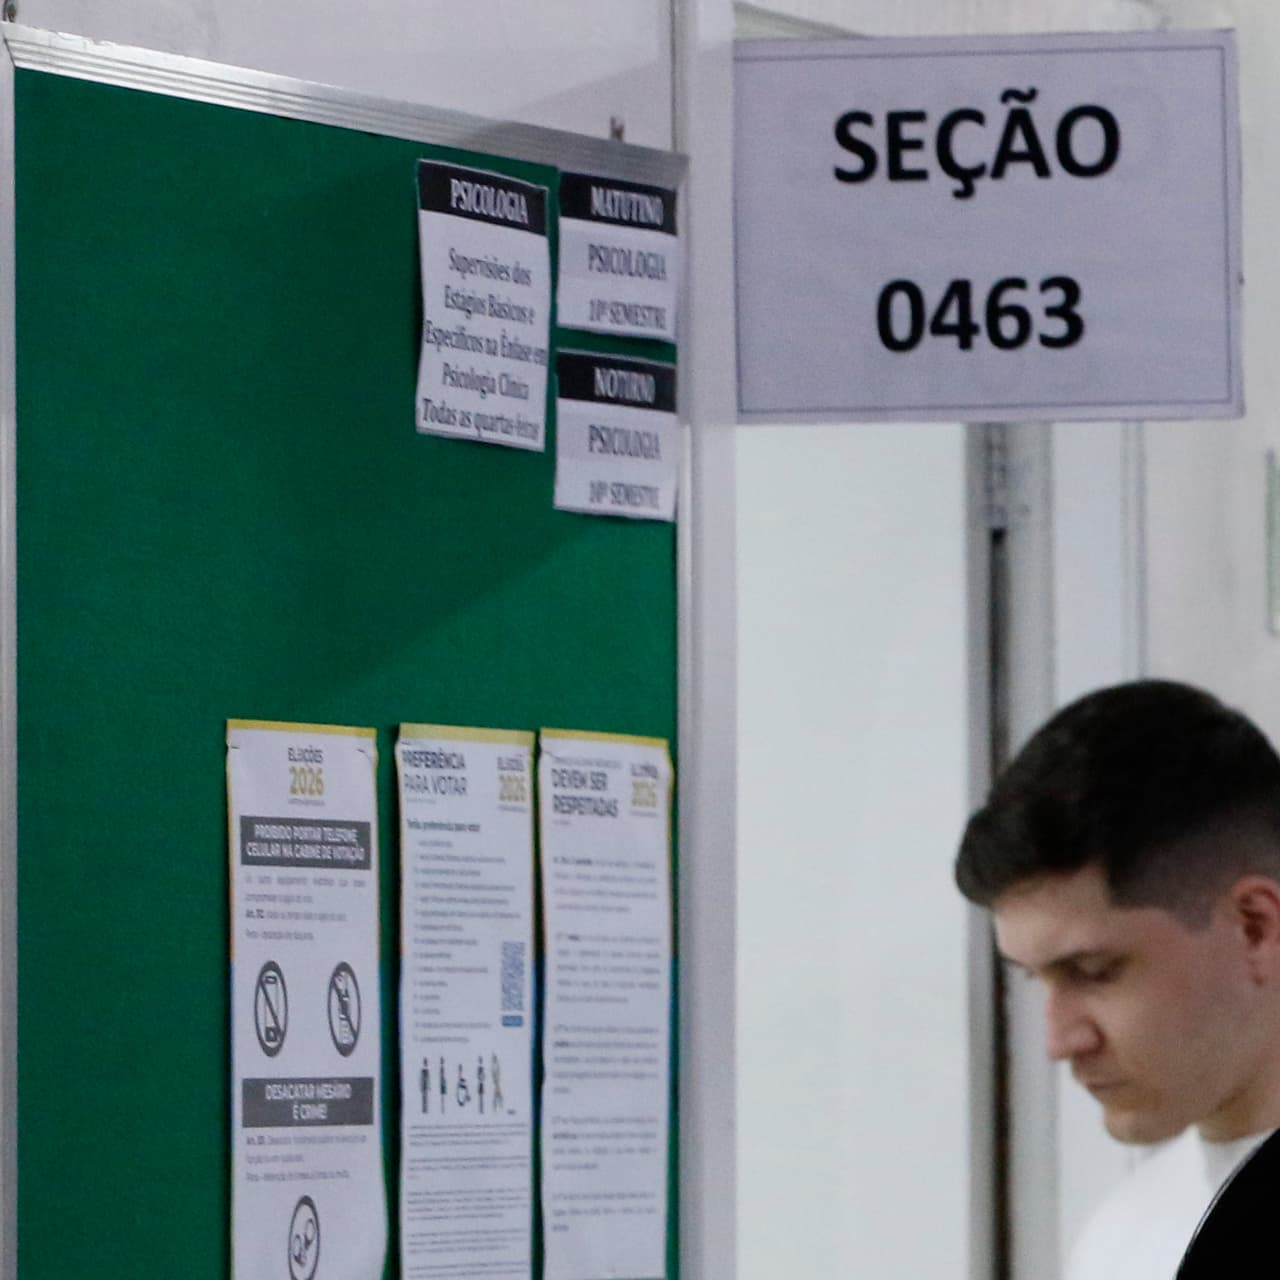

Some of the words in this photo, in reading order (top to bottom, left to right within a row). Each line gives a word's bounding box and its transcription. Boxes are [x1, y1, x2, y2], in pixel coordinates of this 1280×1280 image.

[832, 87, 1121, 200] SEÇÃO
[450, 177, 528, 224] PSICOLOGIA
[591, 186, 664, 226] MATUTINO
[588, 243, 667, 281] PSICOLOGIA
[609, 301, 667, 331] SEMESTRE
[876, 275, 1085, 353] 0463
[594, 367, 656, 403] NOTURNO
[422, 398, 457, 424] Todas
[588, 424, 662, 460] PSICOLOGIA
[401, 747, 466, 770] PREFERÊNCIA
[288, 766, 324, 796] 2026
[404, 773, 429, 793] PARA
[431, 776, 467, 796] VOTAR
[551, 768, 587, 790] DEVEM
[590, 771, 608, 791] SER
[246, 842, 281, 858] CELULAR
[265, 1083, 314, 1100] DESACATAR
